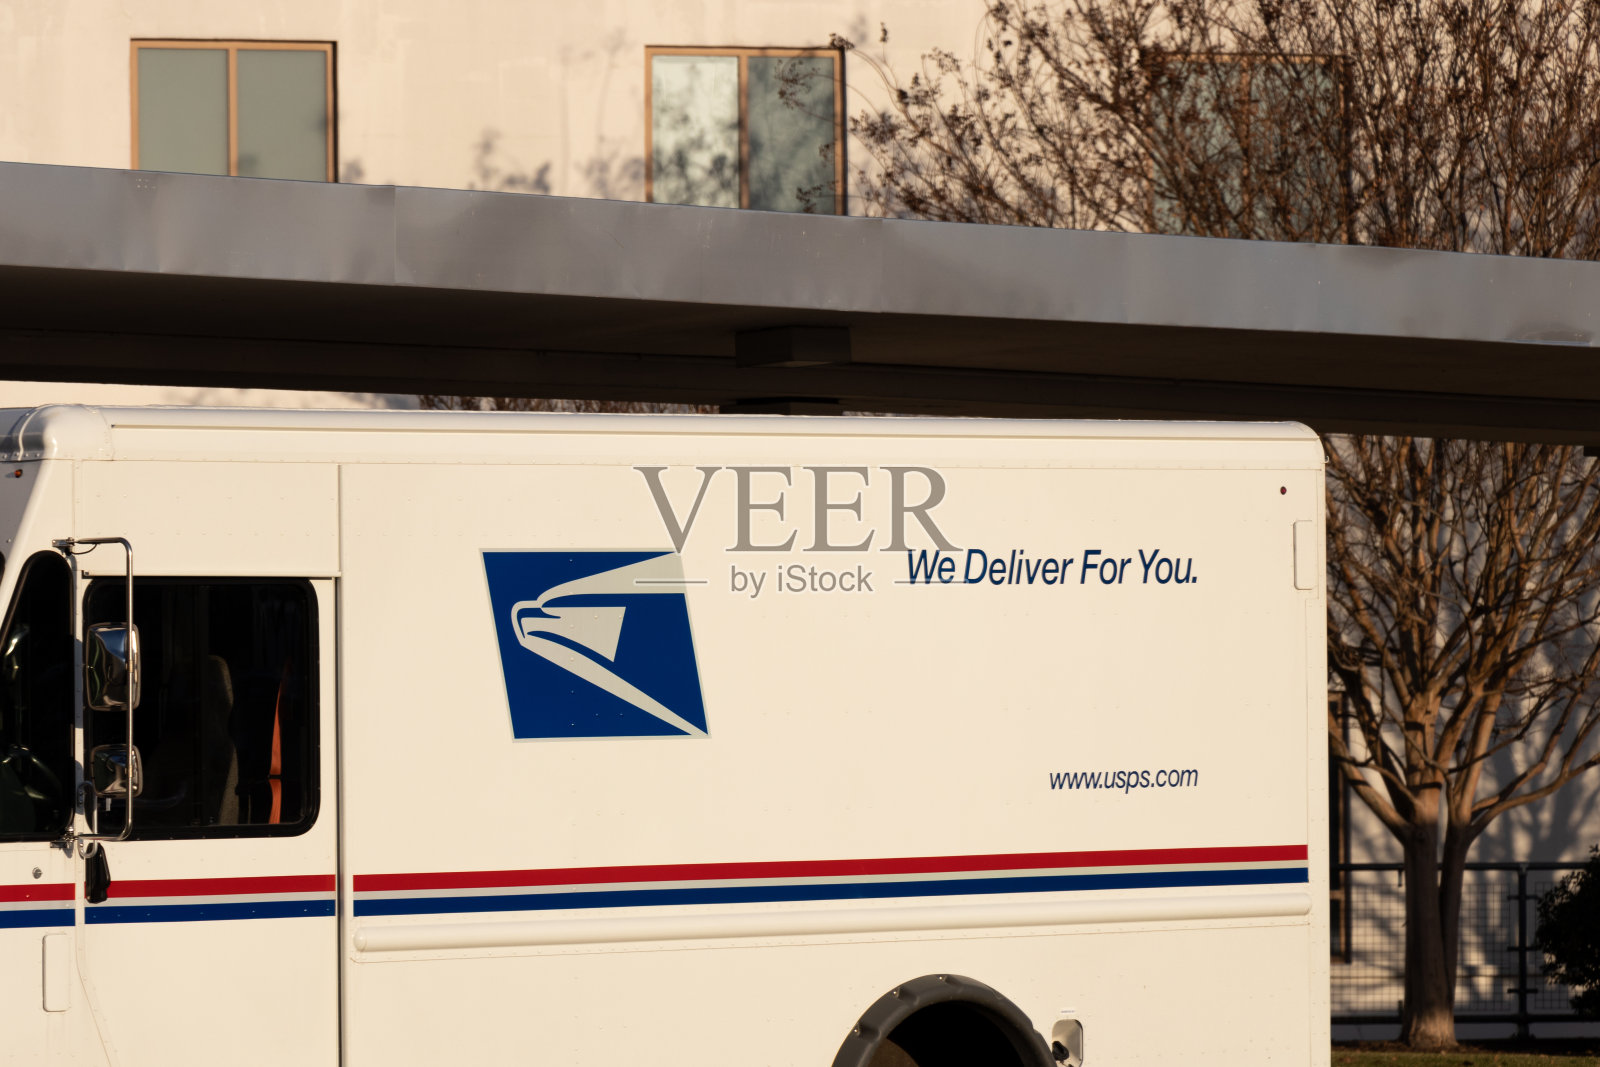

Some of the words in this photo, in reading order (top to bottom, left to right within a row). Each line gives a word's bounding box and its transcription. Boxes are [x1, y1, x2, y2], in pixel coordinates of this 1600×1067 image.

[907, 549, 956, 585] We
[963, 549, 1073, 585] Deliver
[1080, 549, 1131, 585] For
[1137, 549, 1198, 584] You.
[1049, 768, 1199, 794] www.usps.com
